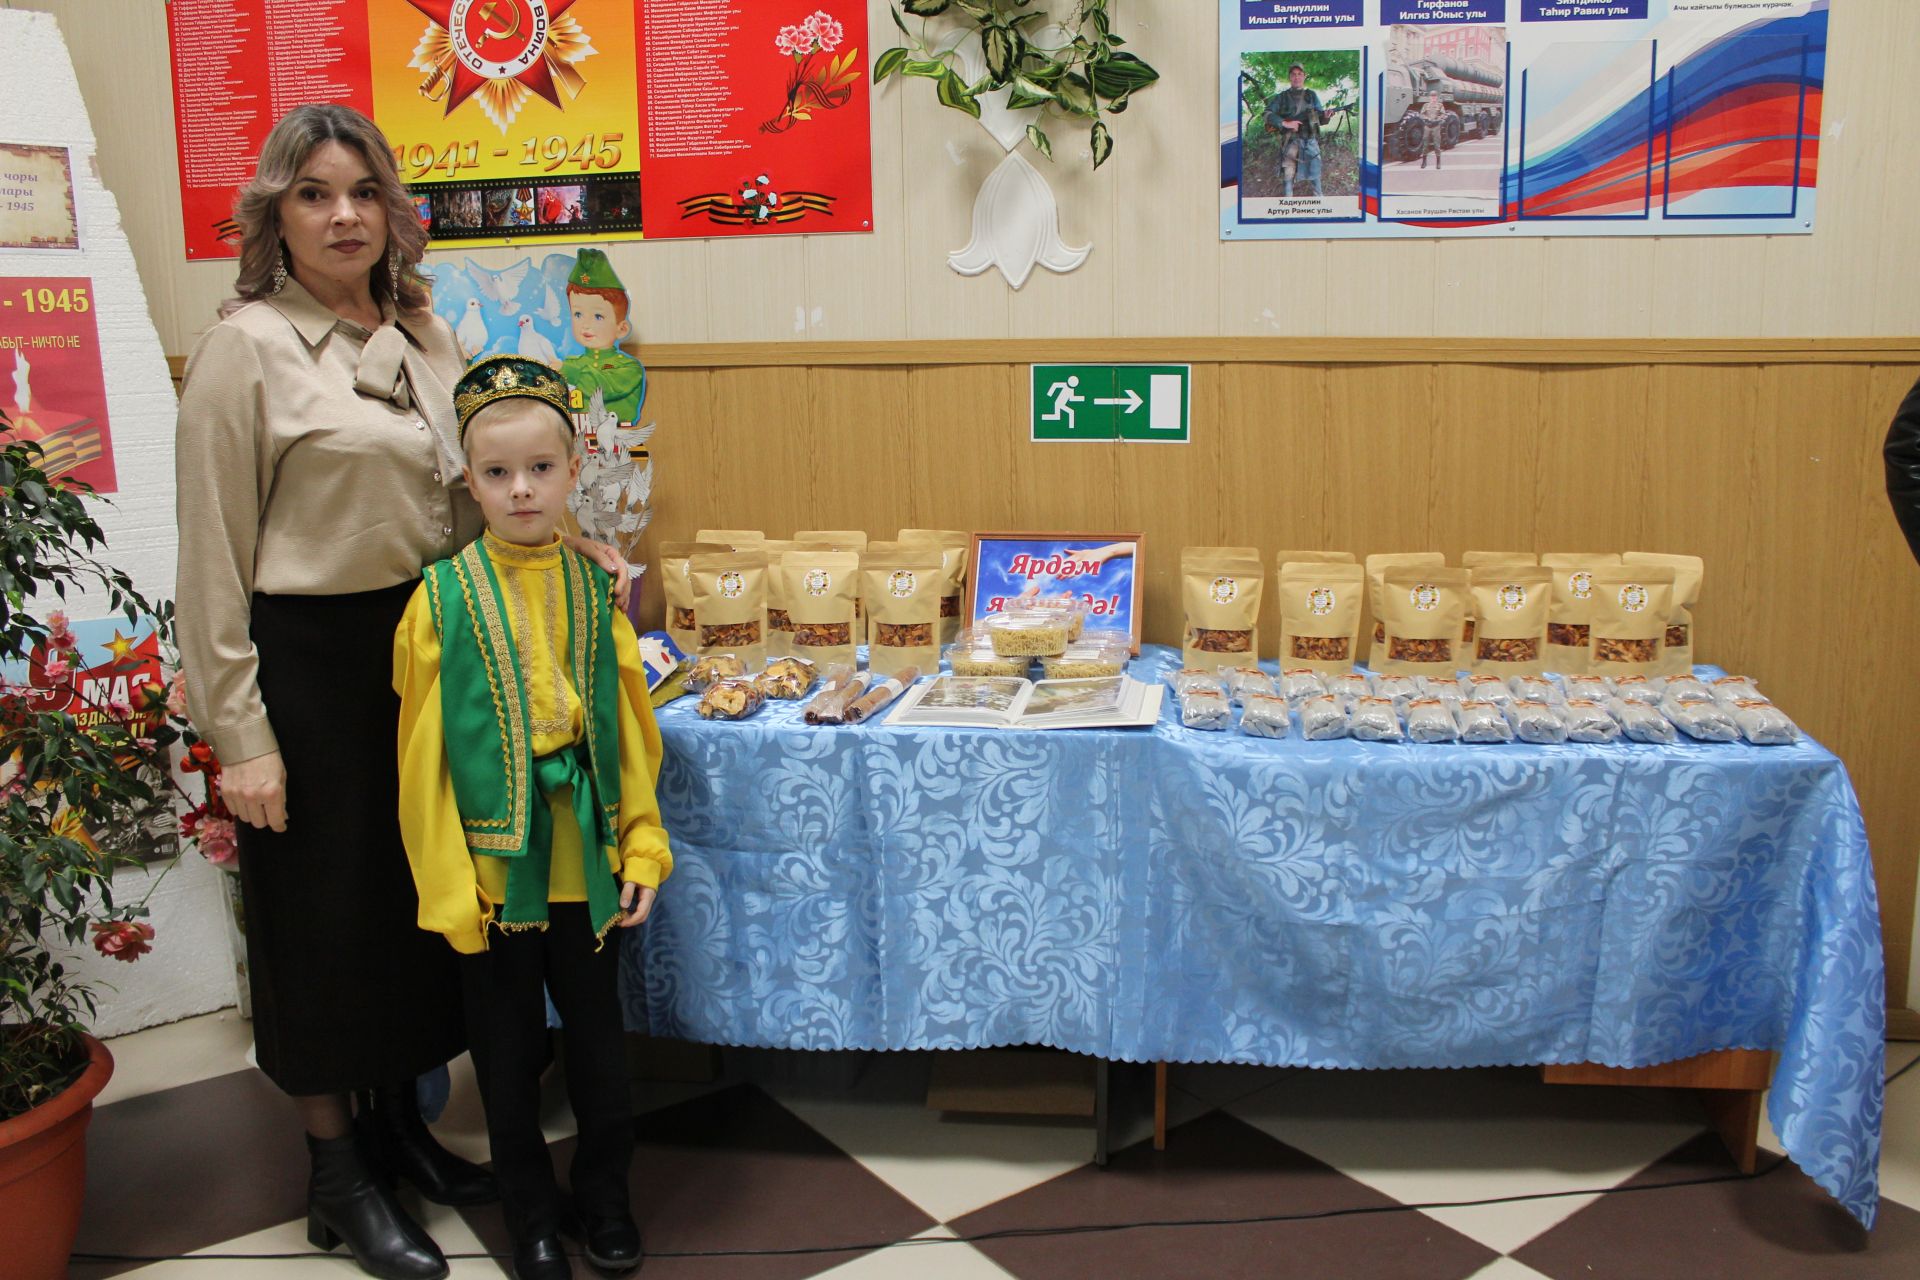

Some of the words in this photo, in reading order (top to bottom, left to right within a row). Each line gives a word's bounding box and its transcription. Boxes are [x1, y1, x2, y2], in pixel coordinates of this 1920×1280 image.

[1273, 4, 1329, 13] Валиуллин
[1417, 0, 1469, 9] Гирфанов
[1399, 11, 1430, 20] Илгиз
[1432, 11, 1464, 20] Юныс
[1466, 11, 1487, 20] улы
[1573, 7, 1605, 16] Равил
[1607, 7, 1629, 17] улы
[1248, 16, 1288, 24] Ильшат
[1290, 15, 1332, 25] Нургали
[1335, 15, 1355, 24] улы
[453, 0, 482, 69] ОТЕЧЕС
[392, 139, 480, 179] 1941
[519, 132, 623, 173] 1945
[4, 172, 38, 183] чоры
[7, 202, 35, 211] 1945
[21, 288, 89, 313] 1945
[31, 335, 65, 348] НИЧТО
[66, 335, 80, 348] НЕ
[1008, 555, 1100, 580] Ярдәм
